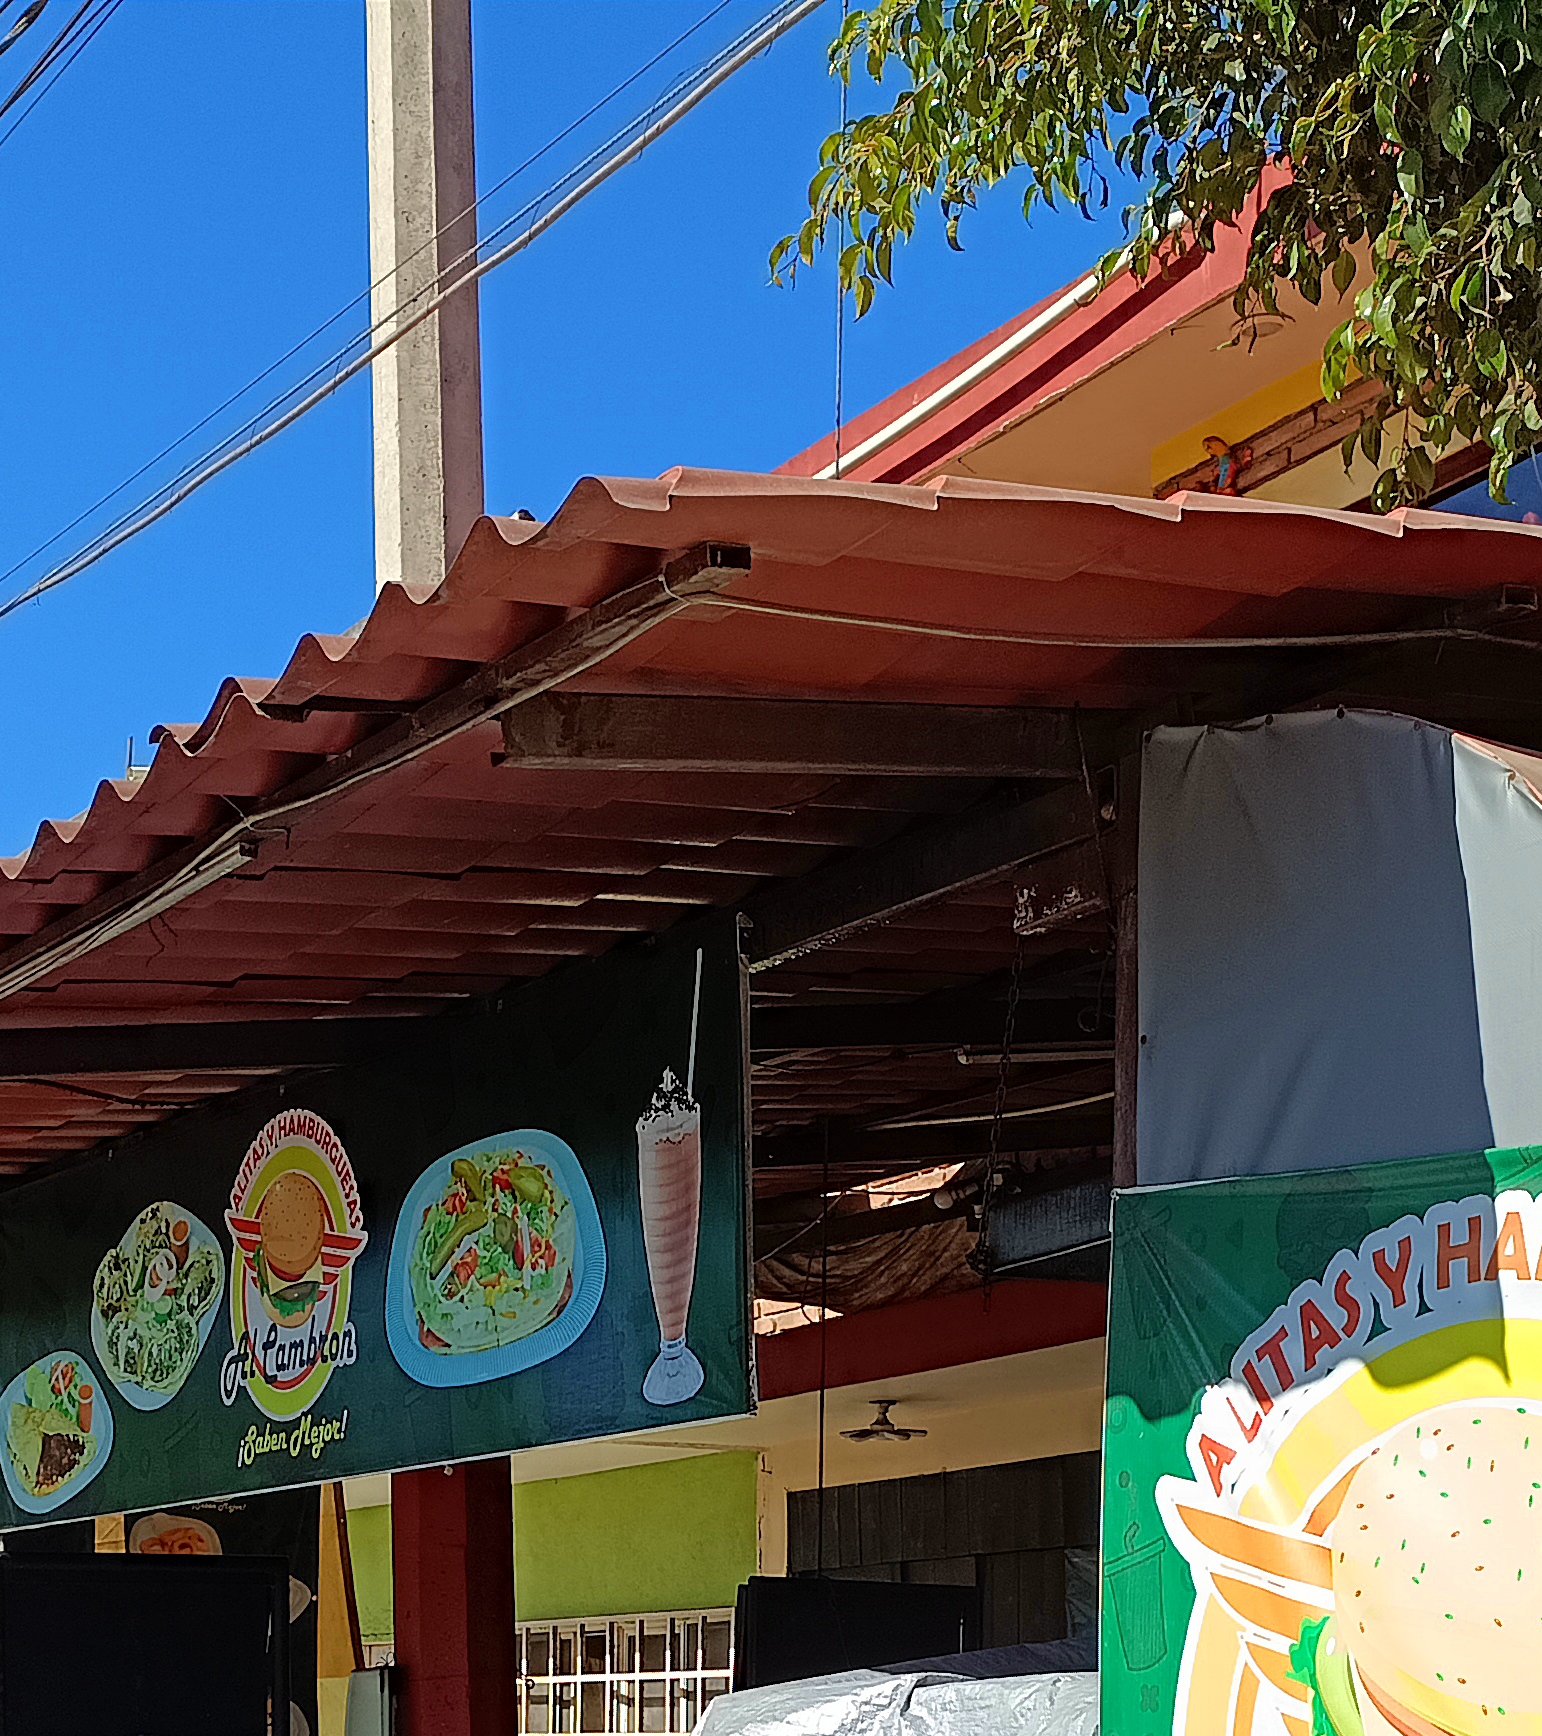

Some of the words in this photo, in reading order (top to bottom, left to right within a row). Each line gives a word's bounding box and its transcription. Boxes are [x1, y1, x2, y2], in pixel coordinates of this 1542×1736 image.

[233, 1136, 265, 1213] ALITAS
[267, 1124, 275, 1146] Y
[278, 1114, 361, 1229] HAMBURGUESAS
[1371, 1242, 1413, 1310] Y
[224, 1328, 257, 1399] Al
[262, 1315, 354, 1384] Cambron
[238, 1423, 287, 1468] ¡Saben
[290, 1409, 348, 1459] Mejor!
